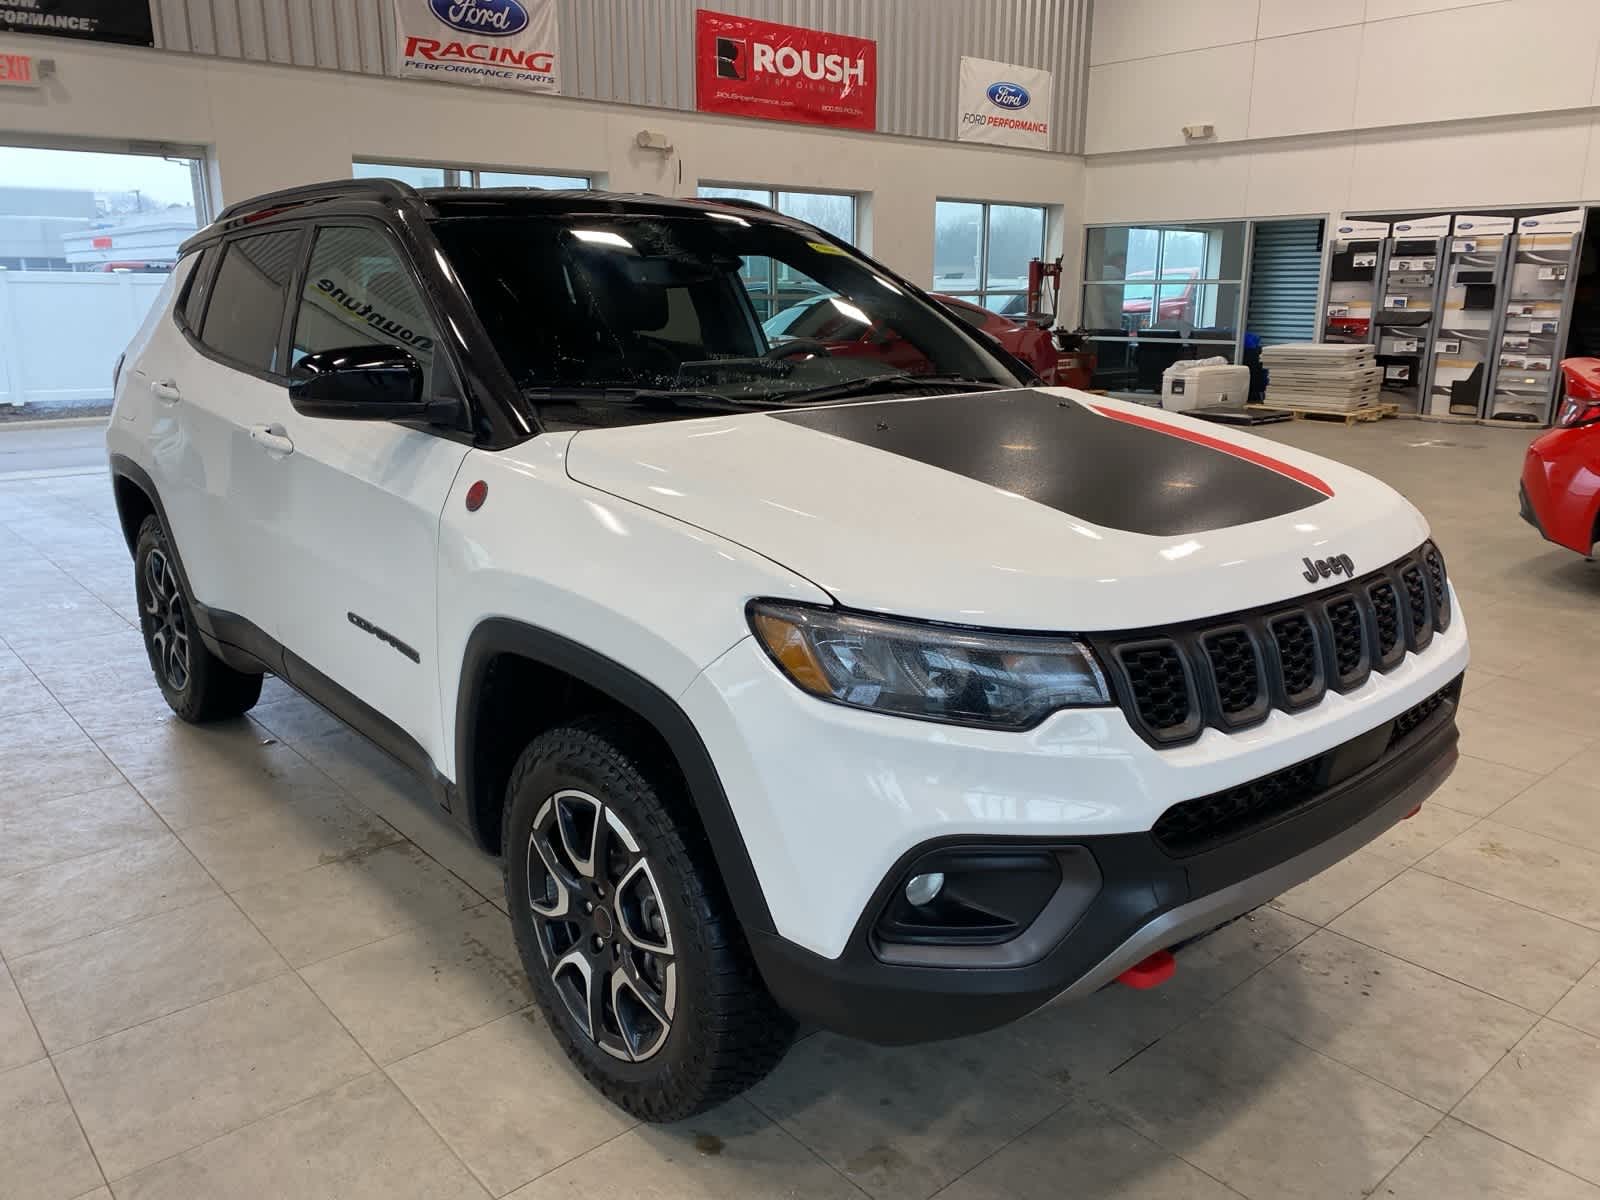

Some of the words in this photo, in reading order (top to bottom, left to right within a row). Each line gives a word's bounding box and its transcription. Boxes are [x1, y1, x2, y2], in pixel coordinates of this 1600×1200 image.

[448, 0, 511, 30] Ford
[405, 36, 555, 73] RACING
[753, 43, 865, 86] ROUSH
[405, 60, 513, 79] PERFORMANCE
[515, 73, 555, 84] PARTS
[995, 86, 1022, 106] Ford
[963, 113, 986, 125] FORD
[987, 116, 1048, 134] PERFORMANCE
[1302, 553, 1354, 583] Jeep
